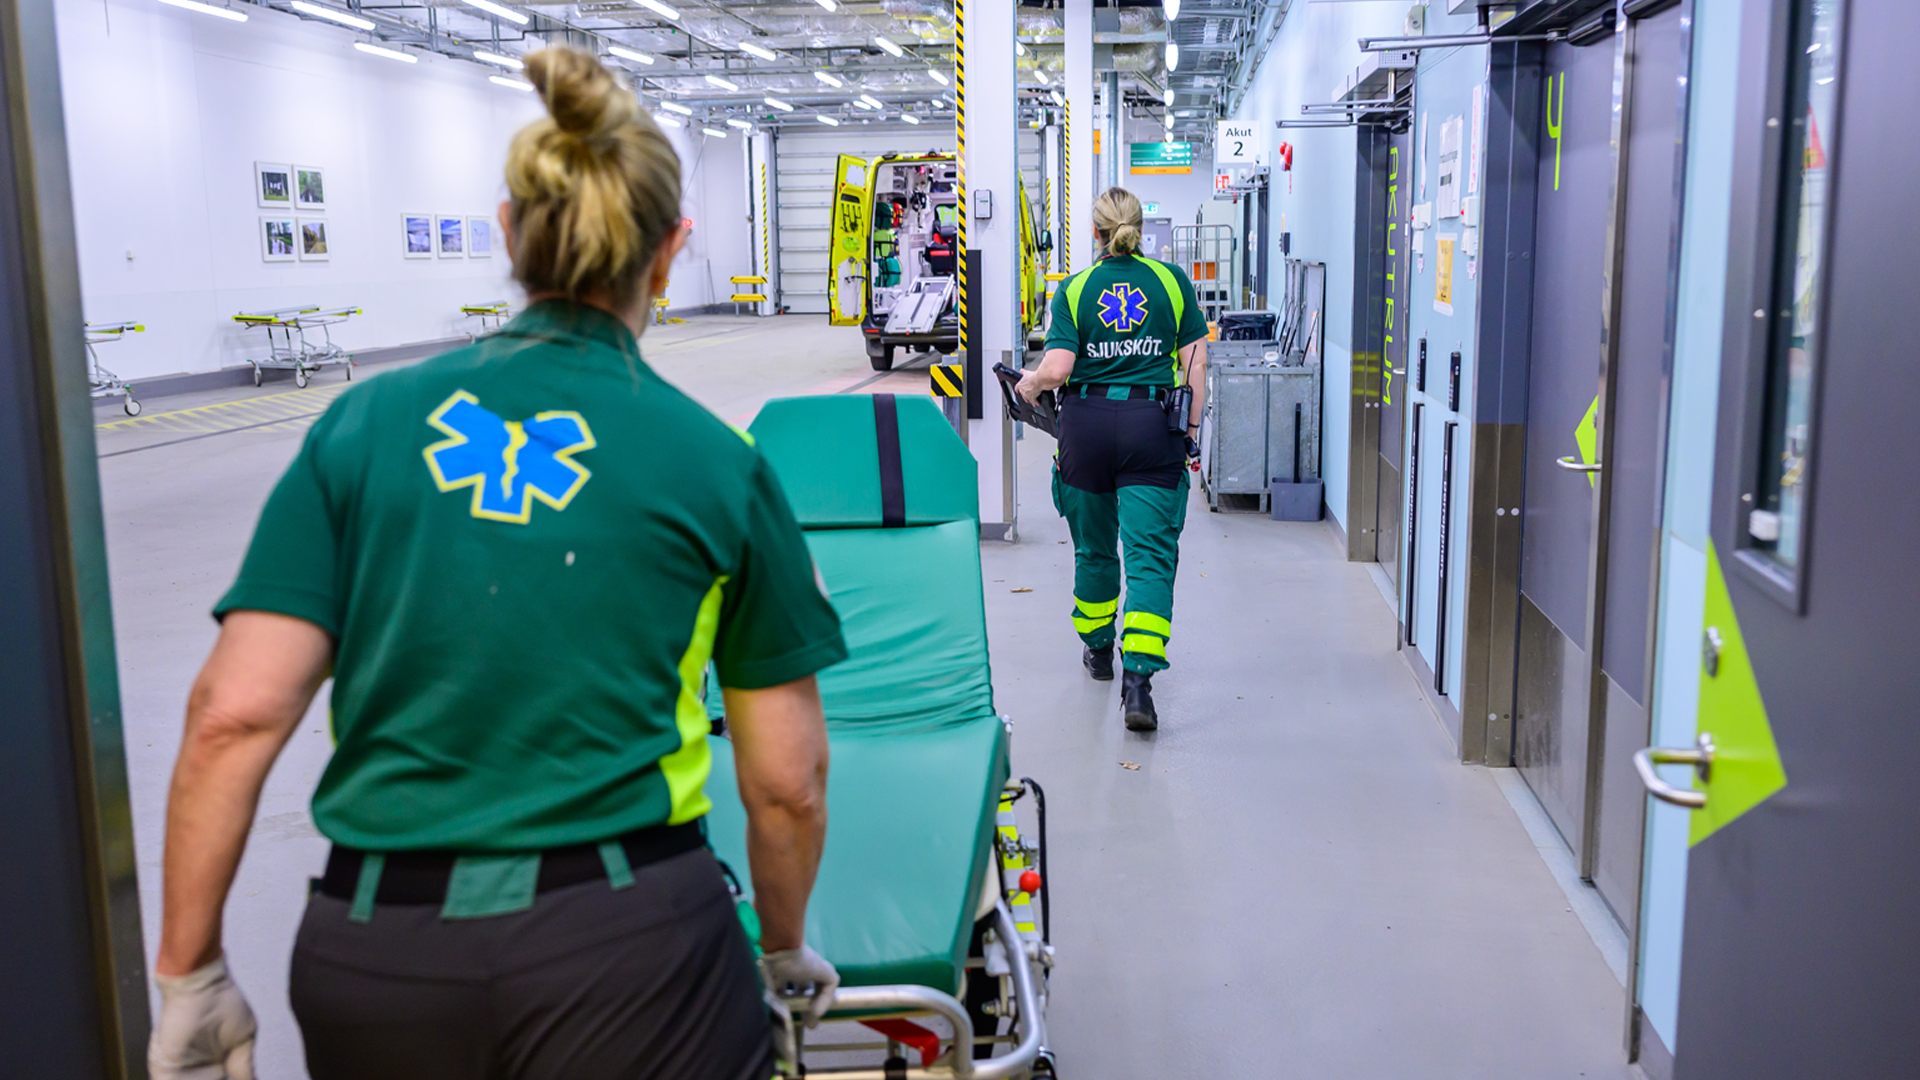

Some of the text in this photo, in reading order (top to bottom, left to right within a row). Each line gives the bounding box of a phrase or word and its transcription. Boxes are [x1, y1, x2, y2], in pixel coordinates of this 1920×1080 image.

[1226, 127, 1252, 137] Akut
[1233, 141, 1244, 156] 2
[1382, 147, 1399, 406] AKUTRUM
[1086, 335, 1162, 359] SJUKSKÖT.
